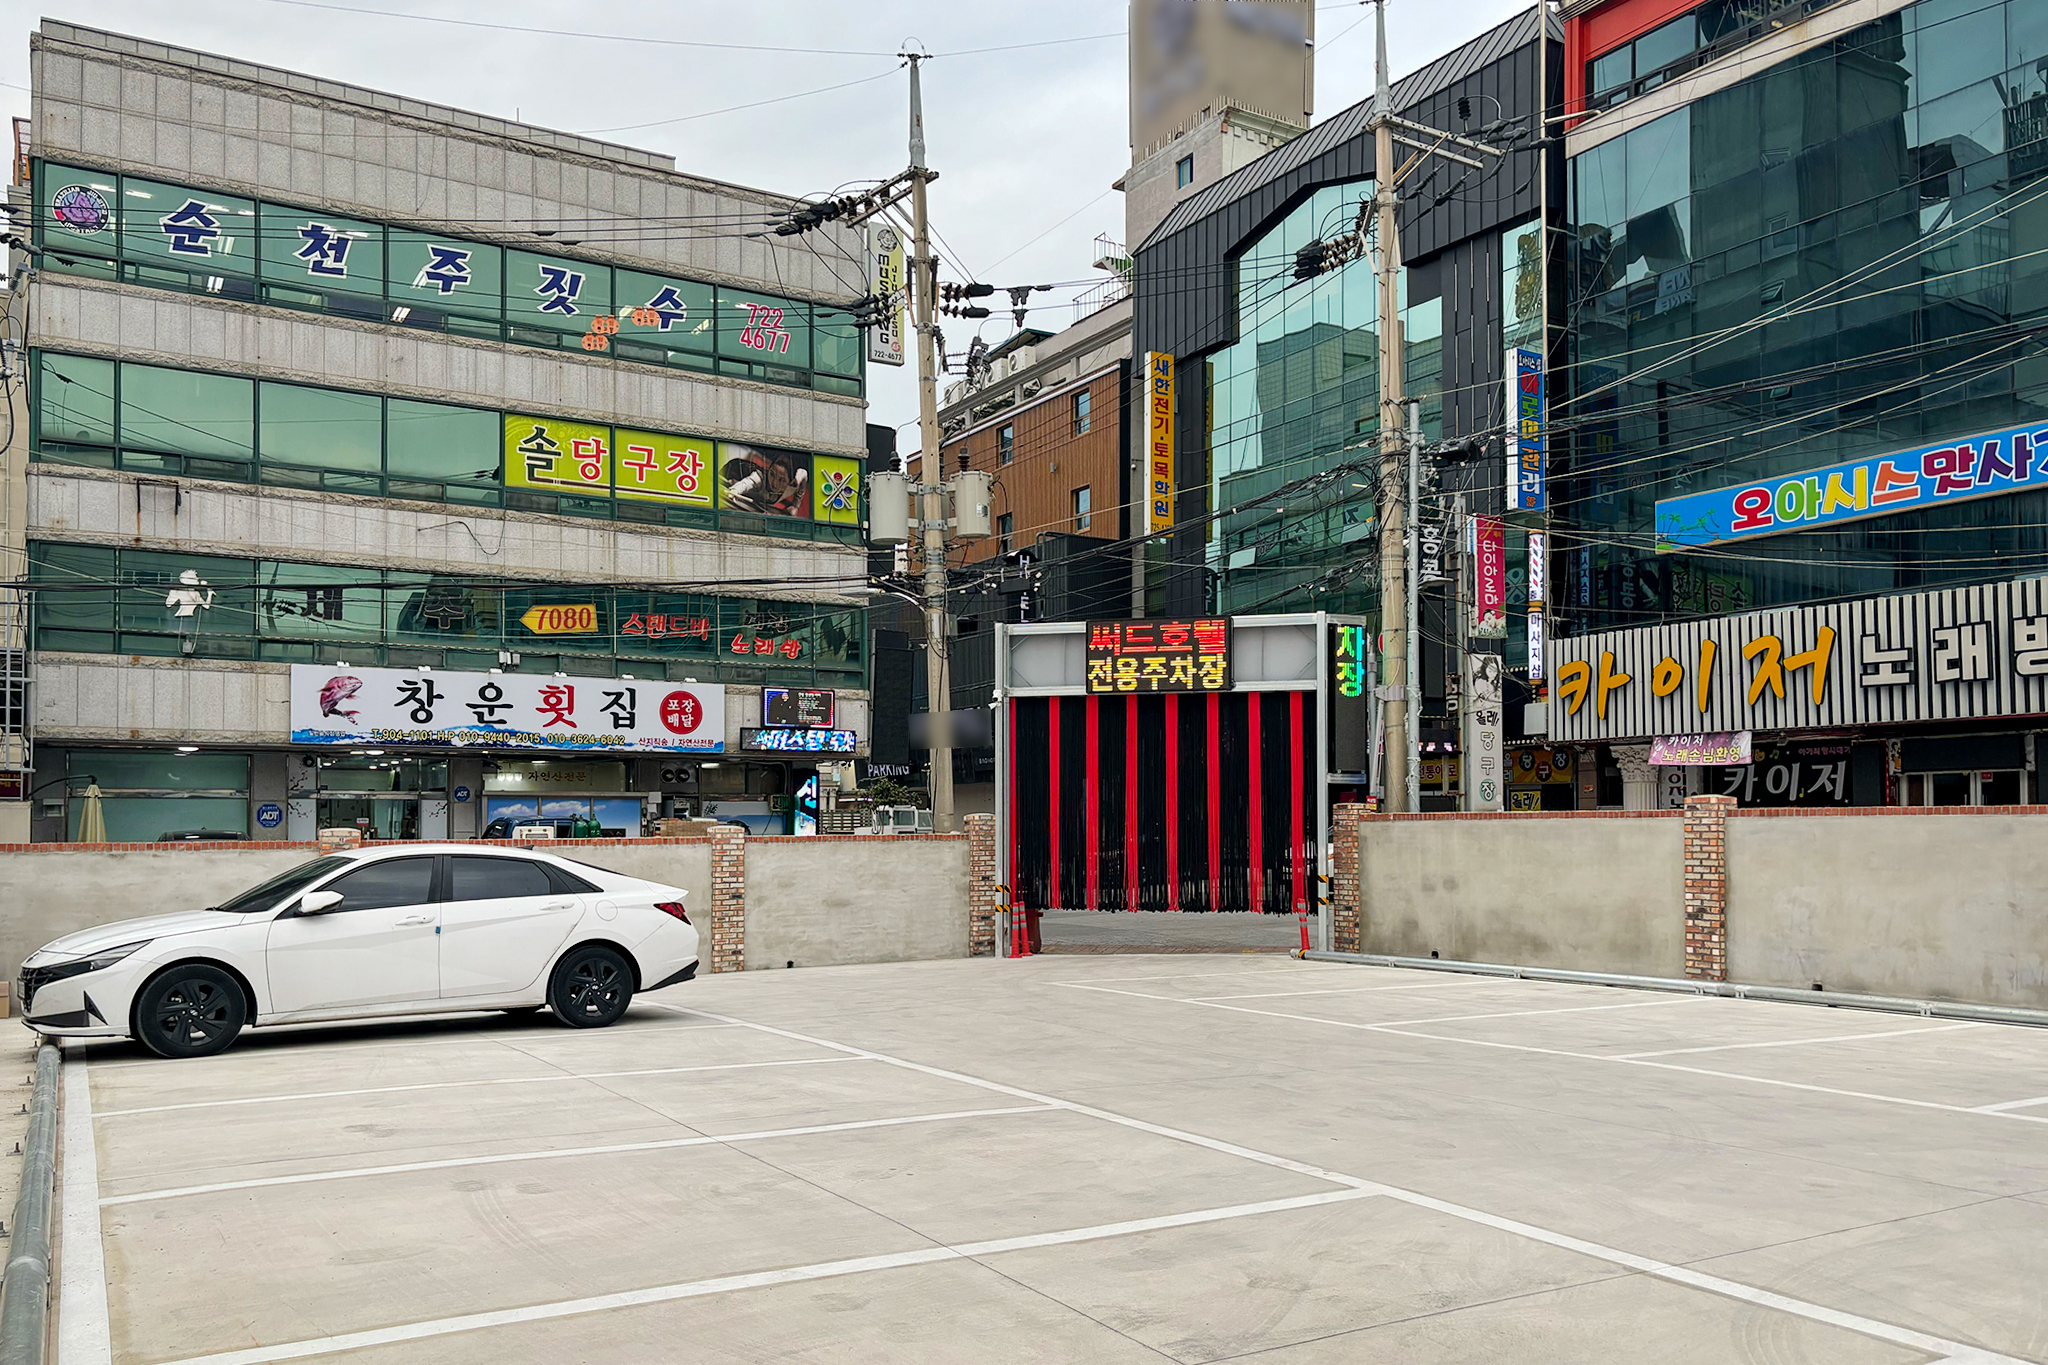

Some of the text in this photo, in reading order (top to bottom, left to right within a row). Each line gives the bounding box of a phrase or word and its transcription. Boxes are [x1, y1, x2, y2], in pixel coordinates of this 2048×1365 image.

[159, 198, 688, 332] 순천주짓수
[743, 303, 785, 330] 722
[740, 327, 791, 354] 4677
[873, 349, 902, 361] 722-4677
[517, 424, 705, 493] 솔당구장
[1482, 540, 1499, 605] 타이아로마
[537, 606, 592, 631] 7080
[621, 612, 711, 643] 스탠드바
[730, 633, 803, 660] 노래방
[1089, 619, 1227, 657] 써드호텔
[1530, 614, 1543, 680] 마사지샵
[1087, 652, 1228, 692] 전용주차장
[1557, 625, 1836, 721] 카이저
[394, 679, 637, 730] 창운횟집
[666, 699, 695, 712] 포장
[667, 714, 695, 728] 배달
[638, 738, 669, 747] 산지직송
[677, 739, 715, 747] 자연산전문
[1662, 747, 1742, 763] 노래손님환영
[1667, 735, 1705, 748] 카이저
[528, 771, 587, 782] 자연산전문
[868, 764, 909, 777] PARKING
[1480, 731, 1497, 802] 당구장
[1522, 751, 1567, 779] 당구장
[1723, 761, 1847, 802] 카이저
[1512, 792, 1540, 811] 올레!
[260, 811, 279, 821] ADT
